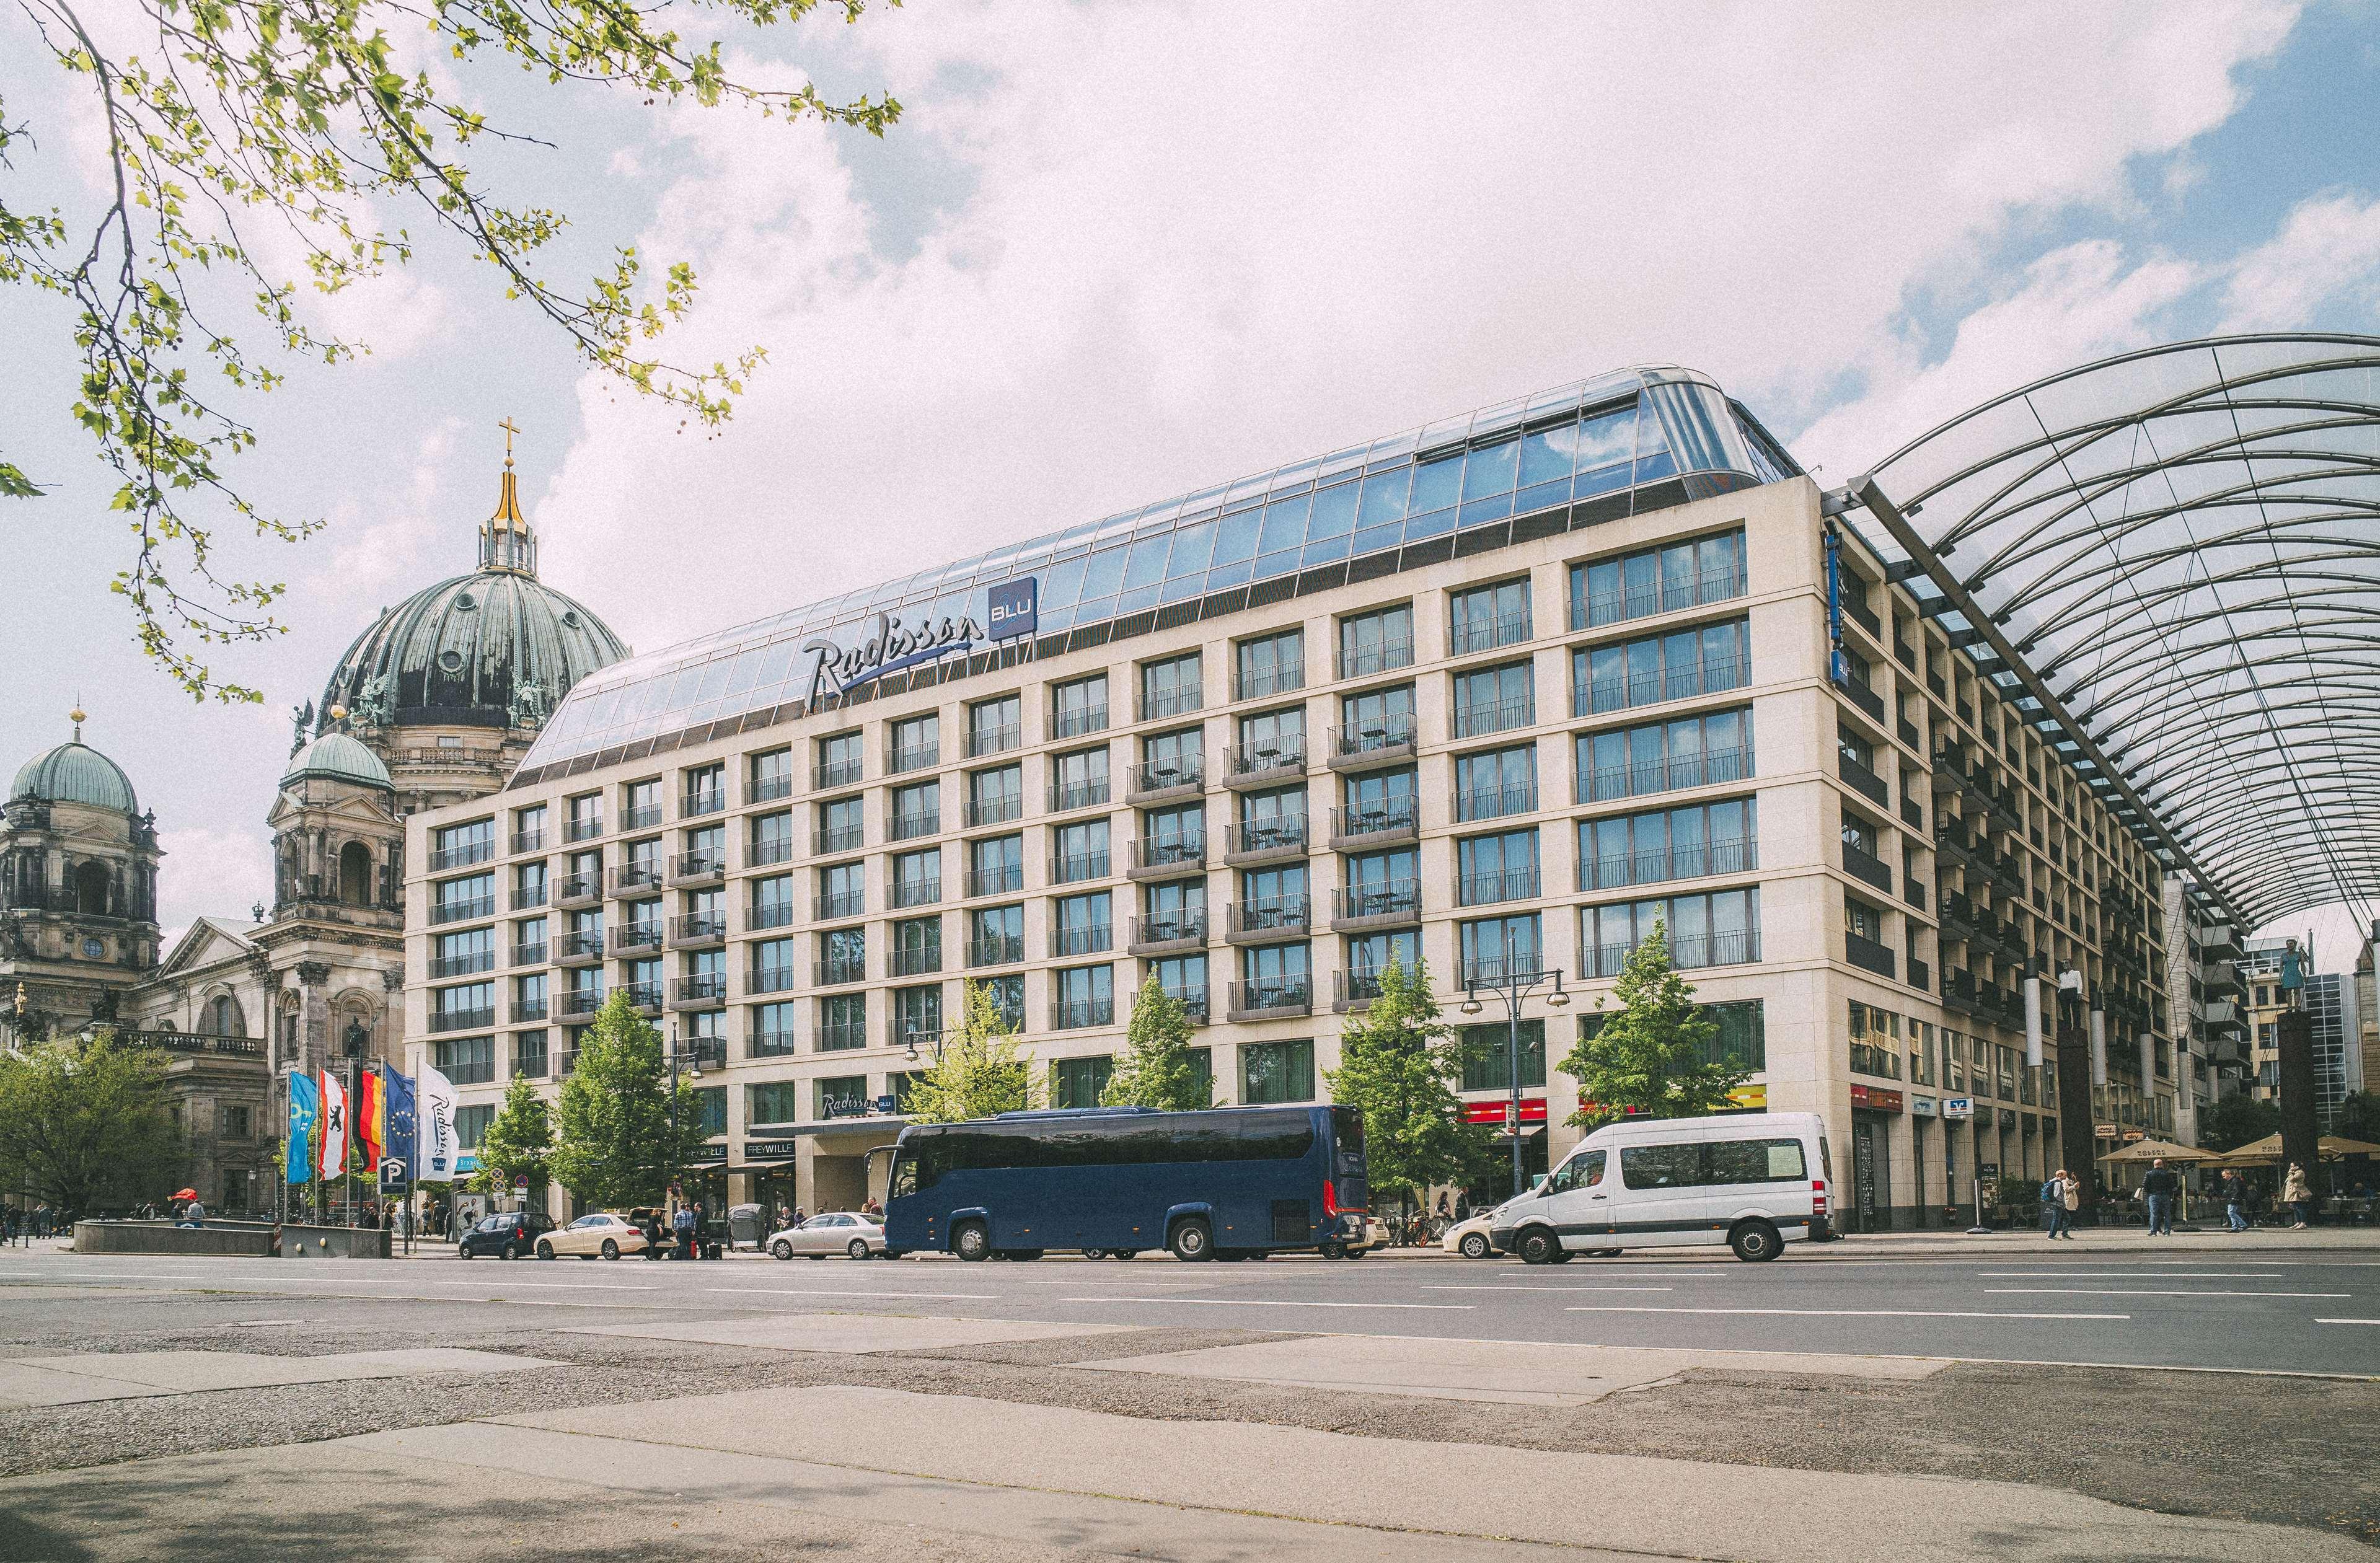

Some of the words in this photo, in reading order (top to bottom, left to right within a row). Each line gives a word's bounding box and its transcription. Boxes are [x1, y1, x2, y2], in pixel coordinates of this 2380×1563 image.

[803, 610, 984, 713] Radisson
[992, 599, 1031, 622] BLU
[823, 1091, 878, 1117] Radisson
[430, 1094, 452, 1156] Radisson
[748, 1143, 792, 1154] FREYWILLE
[388, 1165, 401, 1183] P
